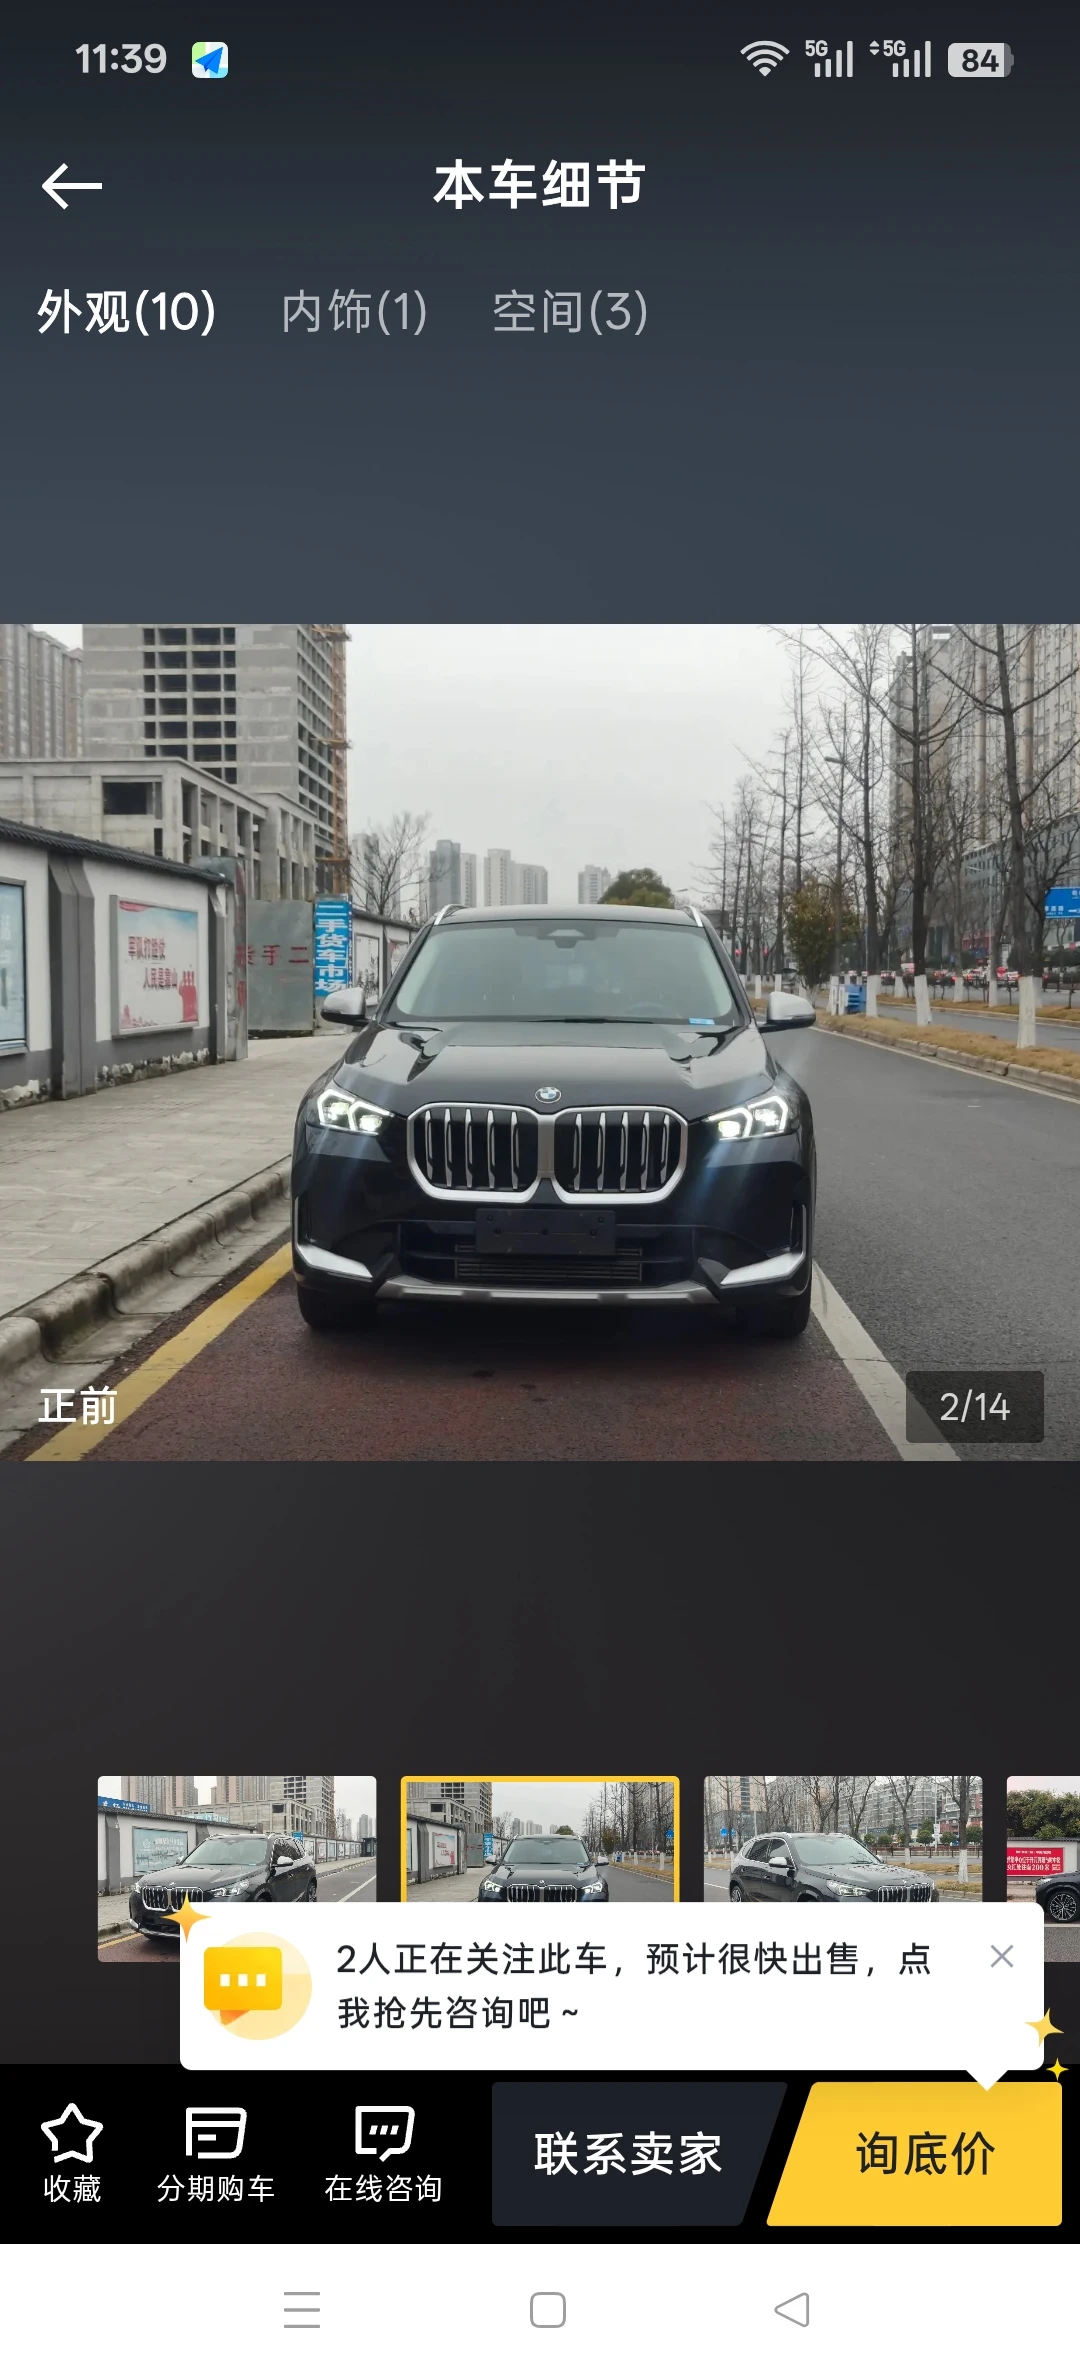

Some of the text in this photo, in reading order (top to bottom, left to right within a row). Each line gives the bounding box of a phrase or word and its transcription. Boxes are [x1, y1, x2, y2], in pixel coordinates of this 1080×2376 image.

[76, 44, 166, 73] 11:39
[805, 40, 828, 56] 5G
[883, 40, 906, 56] 5G
[961, 49, 1000, 72] 84
[433, 158, 646, 209] 本车细节
[37, 289, 215, 336] 外观(10)
[282, 289, 427, 336] 内饰(1)
[492, 289, 648, 336] 空间(3)
[315, 904, 348, 993] 二手货车市场
[534, 2131, 722, 2176] 联系卖家
[856, 2131, 996, 2176] 询底价
[43, 2174, 102, 2203] 收藏
[156, 2174, 275, 2203] 分期购车
[324, 2174, 442, 2203] 在线咨询
